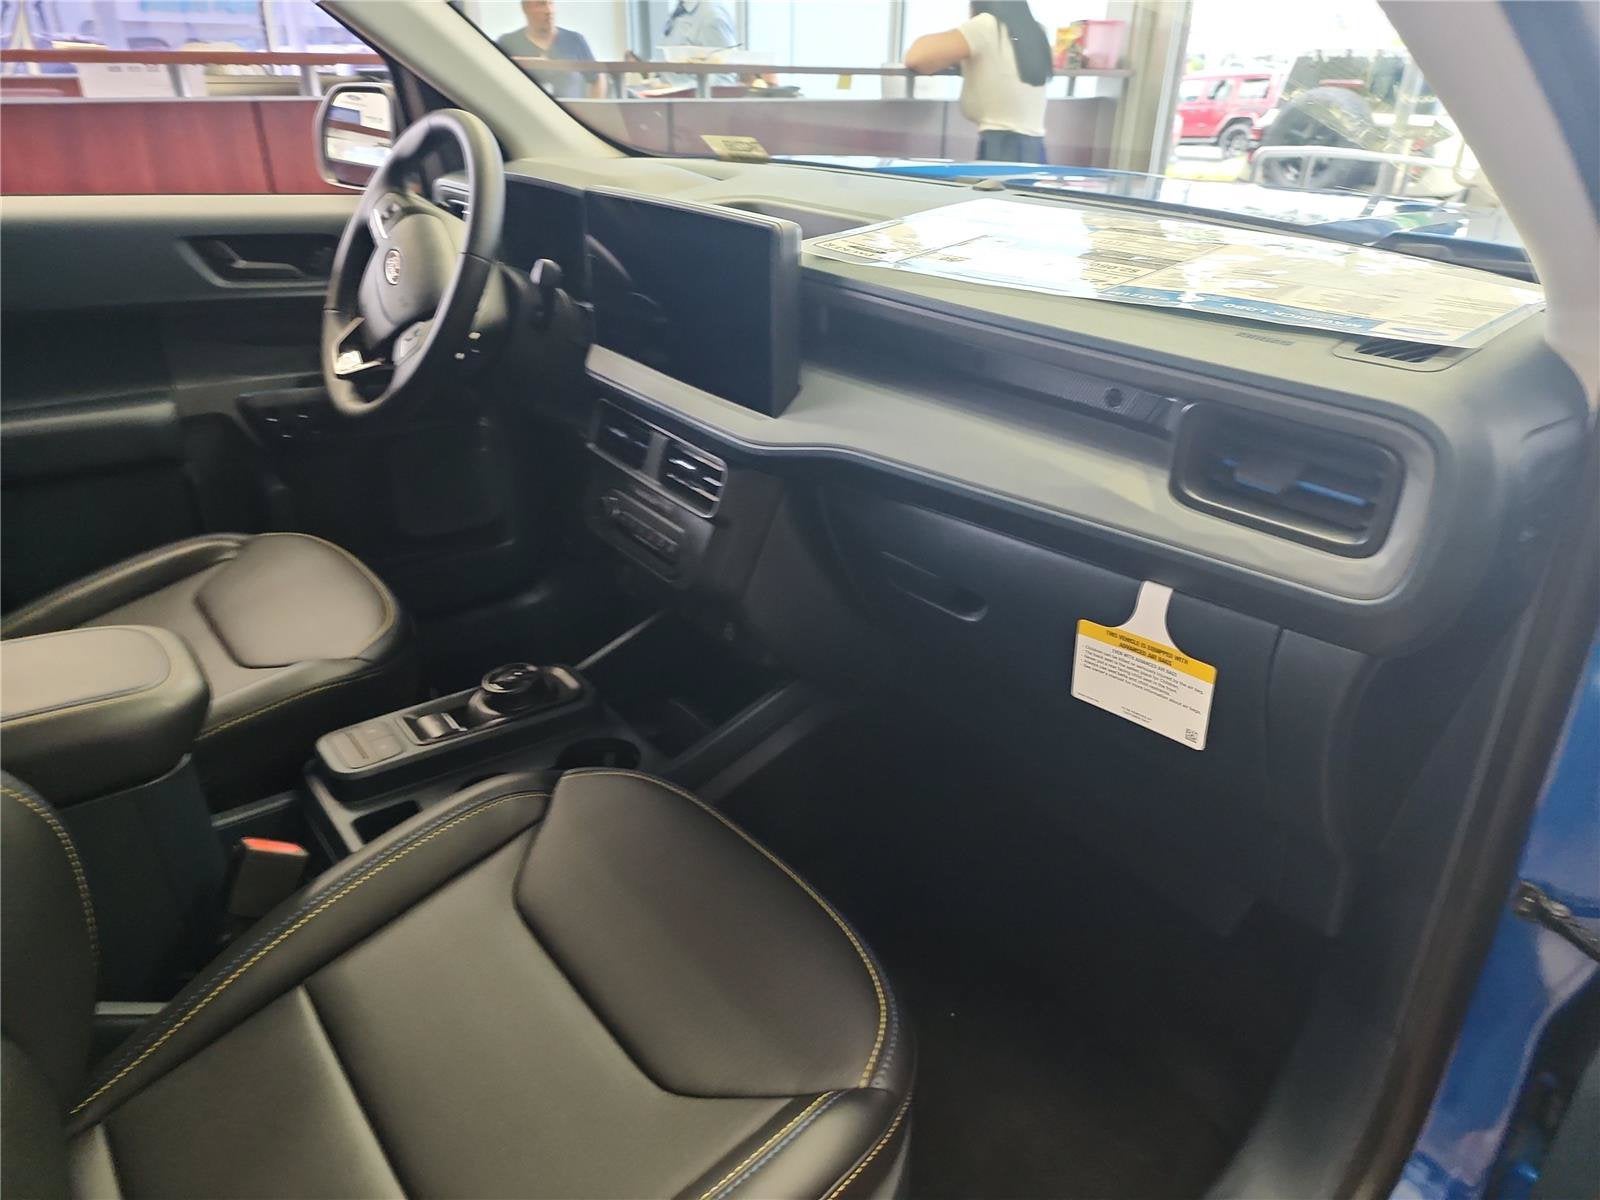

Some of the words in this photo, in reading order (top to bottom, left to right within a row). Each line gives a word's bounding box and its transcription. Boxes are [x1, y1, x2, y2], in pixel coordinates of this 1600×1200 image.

[1222, 303, 1269, 314] LOBO
[1272, 311, 1363, 328] MAVERICK
[1118, 634, 1140, 646] VEHICLE
[1174, 655, 1188, 664] WITH
[1119, 641, 1146, 656] ADVANCED
